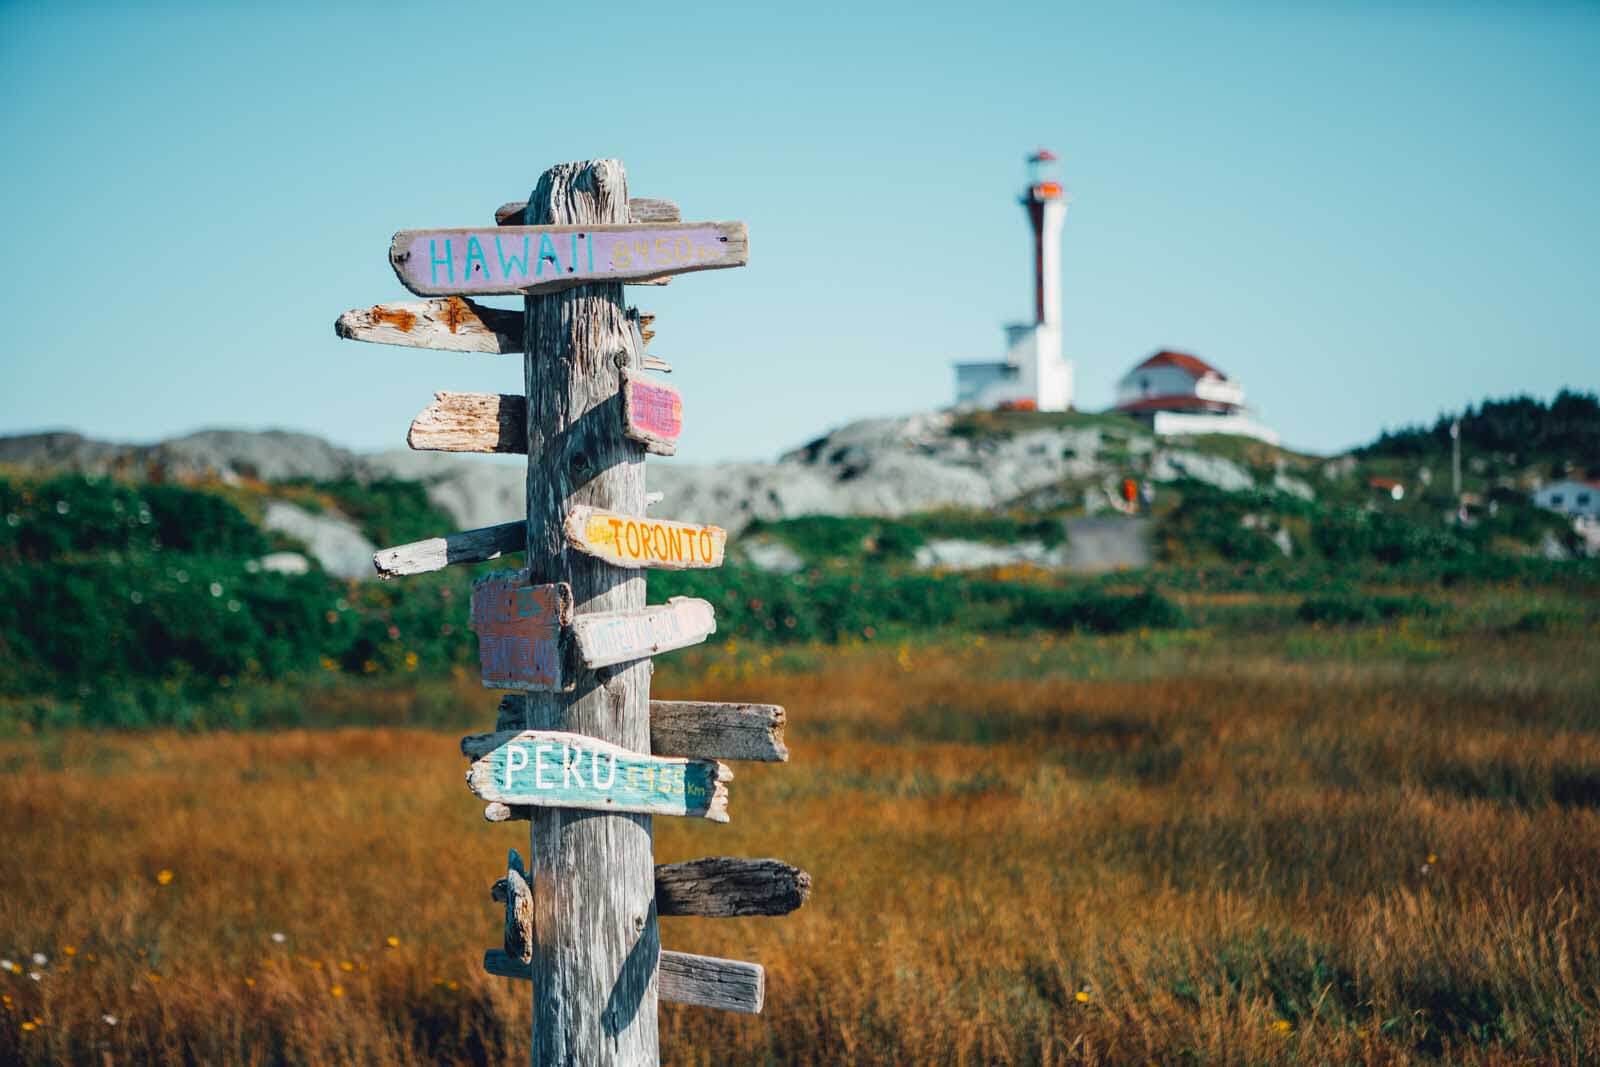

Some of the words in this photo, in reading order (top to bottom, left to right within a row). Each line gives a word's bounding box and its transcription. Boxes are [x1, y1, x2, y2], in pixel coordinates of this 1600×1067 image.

[430, 231, 593, 285] HAWAII
[608, 518, 713, 563] TORONTO
[504, 744, 616, 790] PERU
